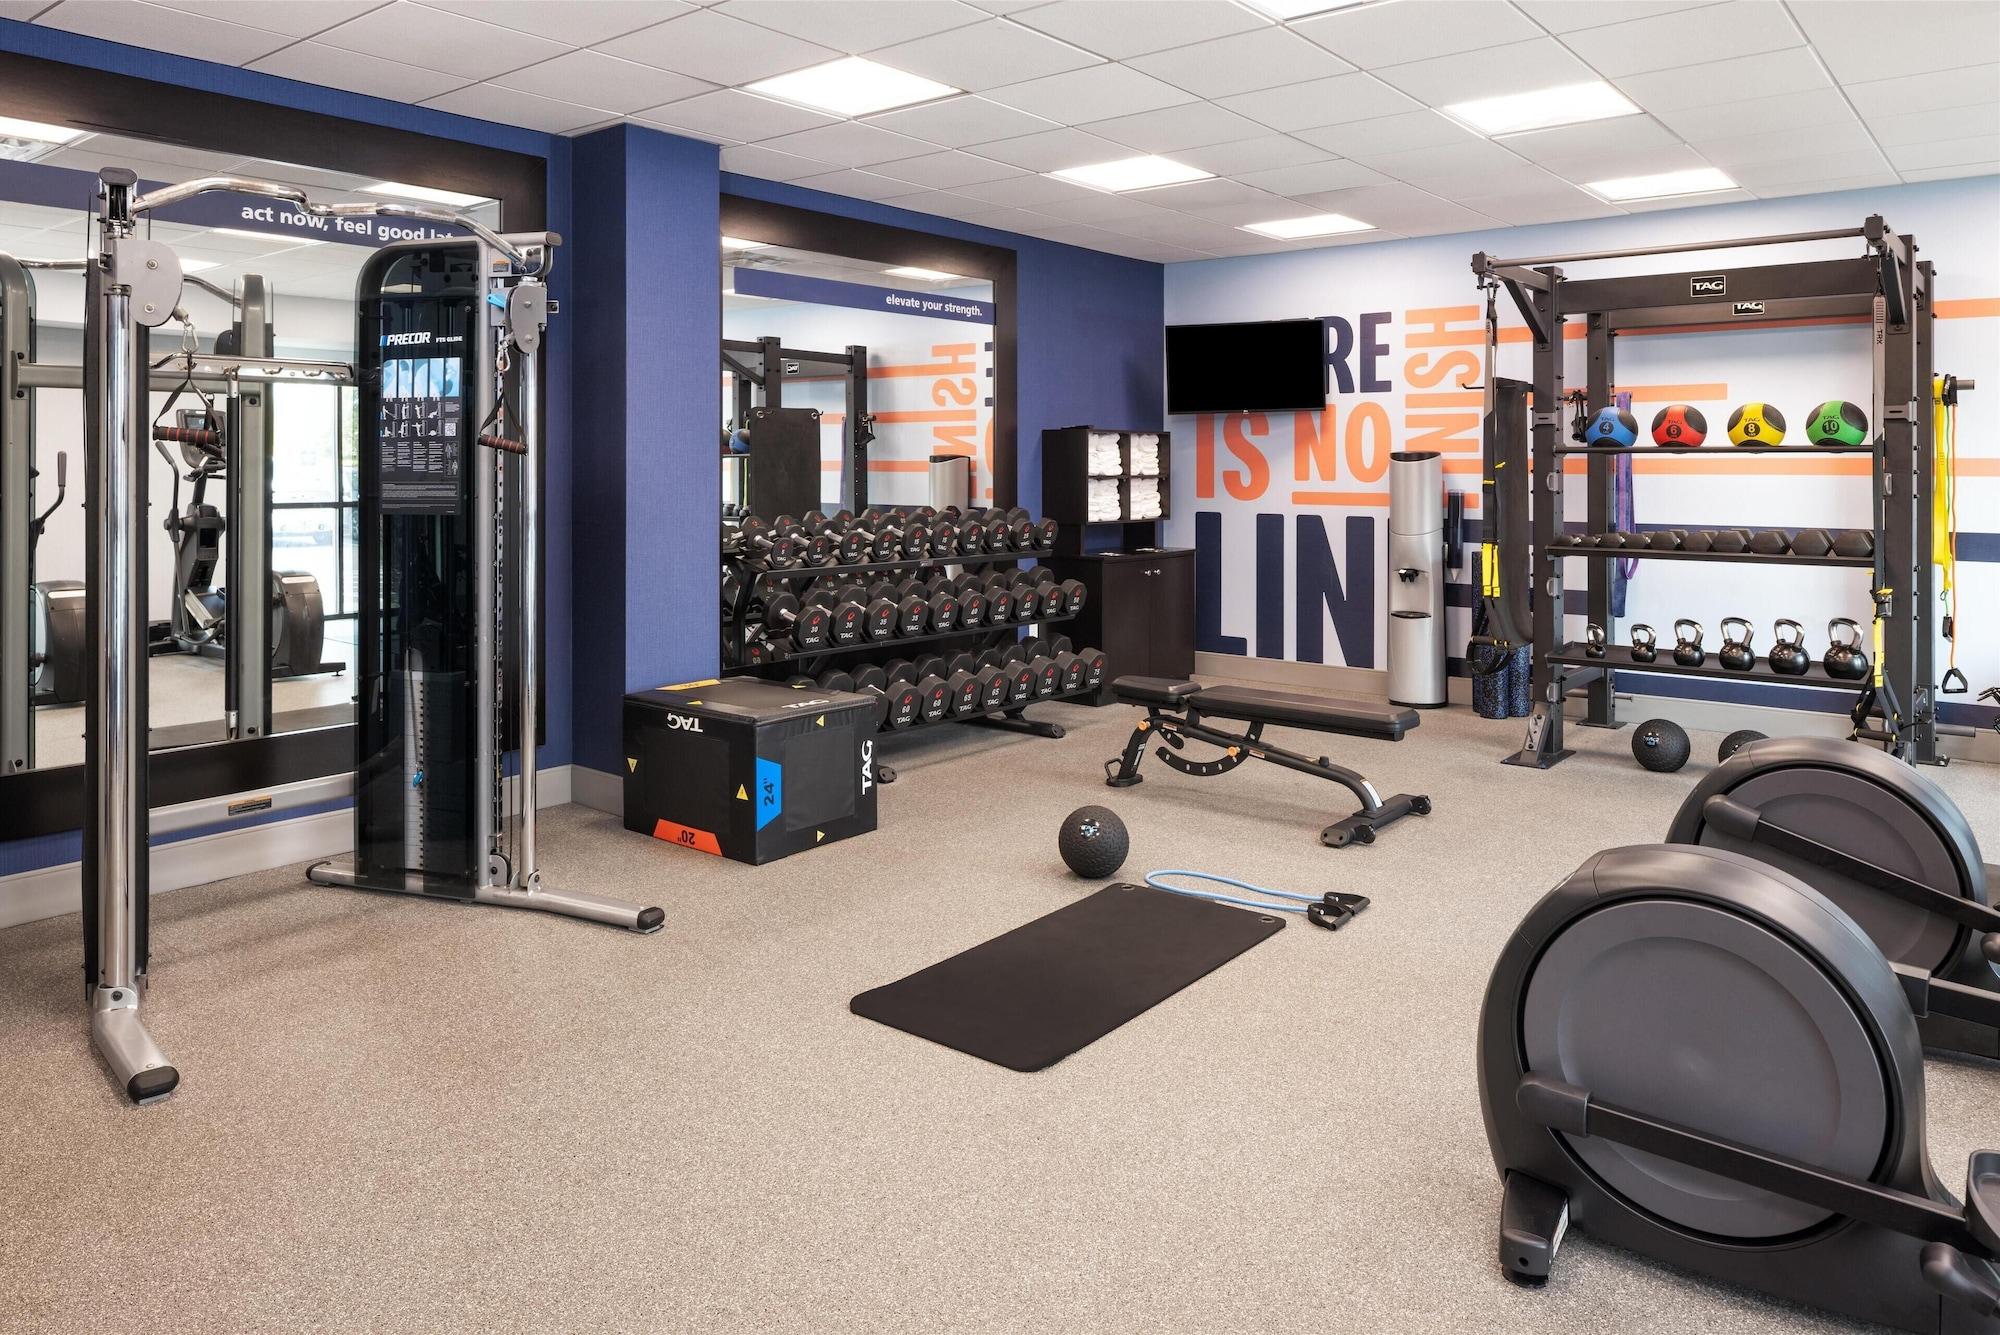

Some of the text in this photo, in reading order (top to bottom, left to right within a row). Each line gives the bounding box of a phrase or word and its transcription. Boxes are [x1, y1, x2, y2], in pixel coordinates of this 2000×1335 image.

[241, 206, 274, 222] act
[280, 211, 329, 232] now,
[335, 216, 372, 236] feel
[378, 225, 424, 242] good
[1692, 281, 1724, 291] TAG
[886, 294, 982, 317] elevate your strength.
[1734, 302, 1764, 310] TAG
[387, 332, 431, 346] PRECOR
[1748, 424, 1755, 432] 8
[1824, 421, 1837, 430] 10
[1196, 402, 1392, 501] IS NO
[1196, 512, 1374, 669] LIN
[782, 700, 830, 709] TAG
[667, 712, 704, 732] TAG
[862, 740, 873, 796] TAG
[764, 777, 775, 806] 24"
[677, 830, 695, 845] 20"
